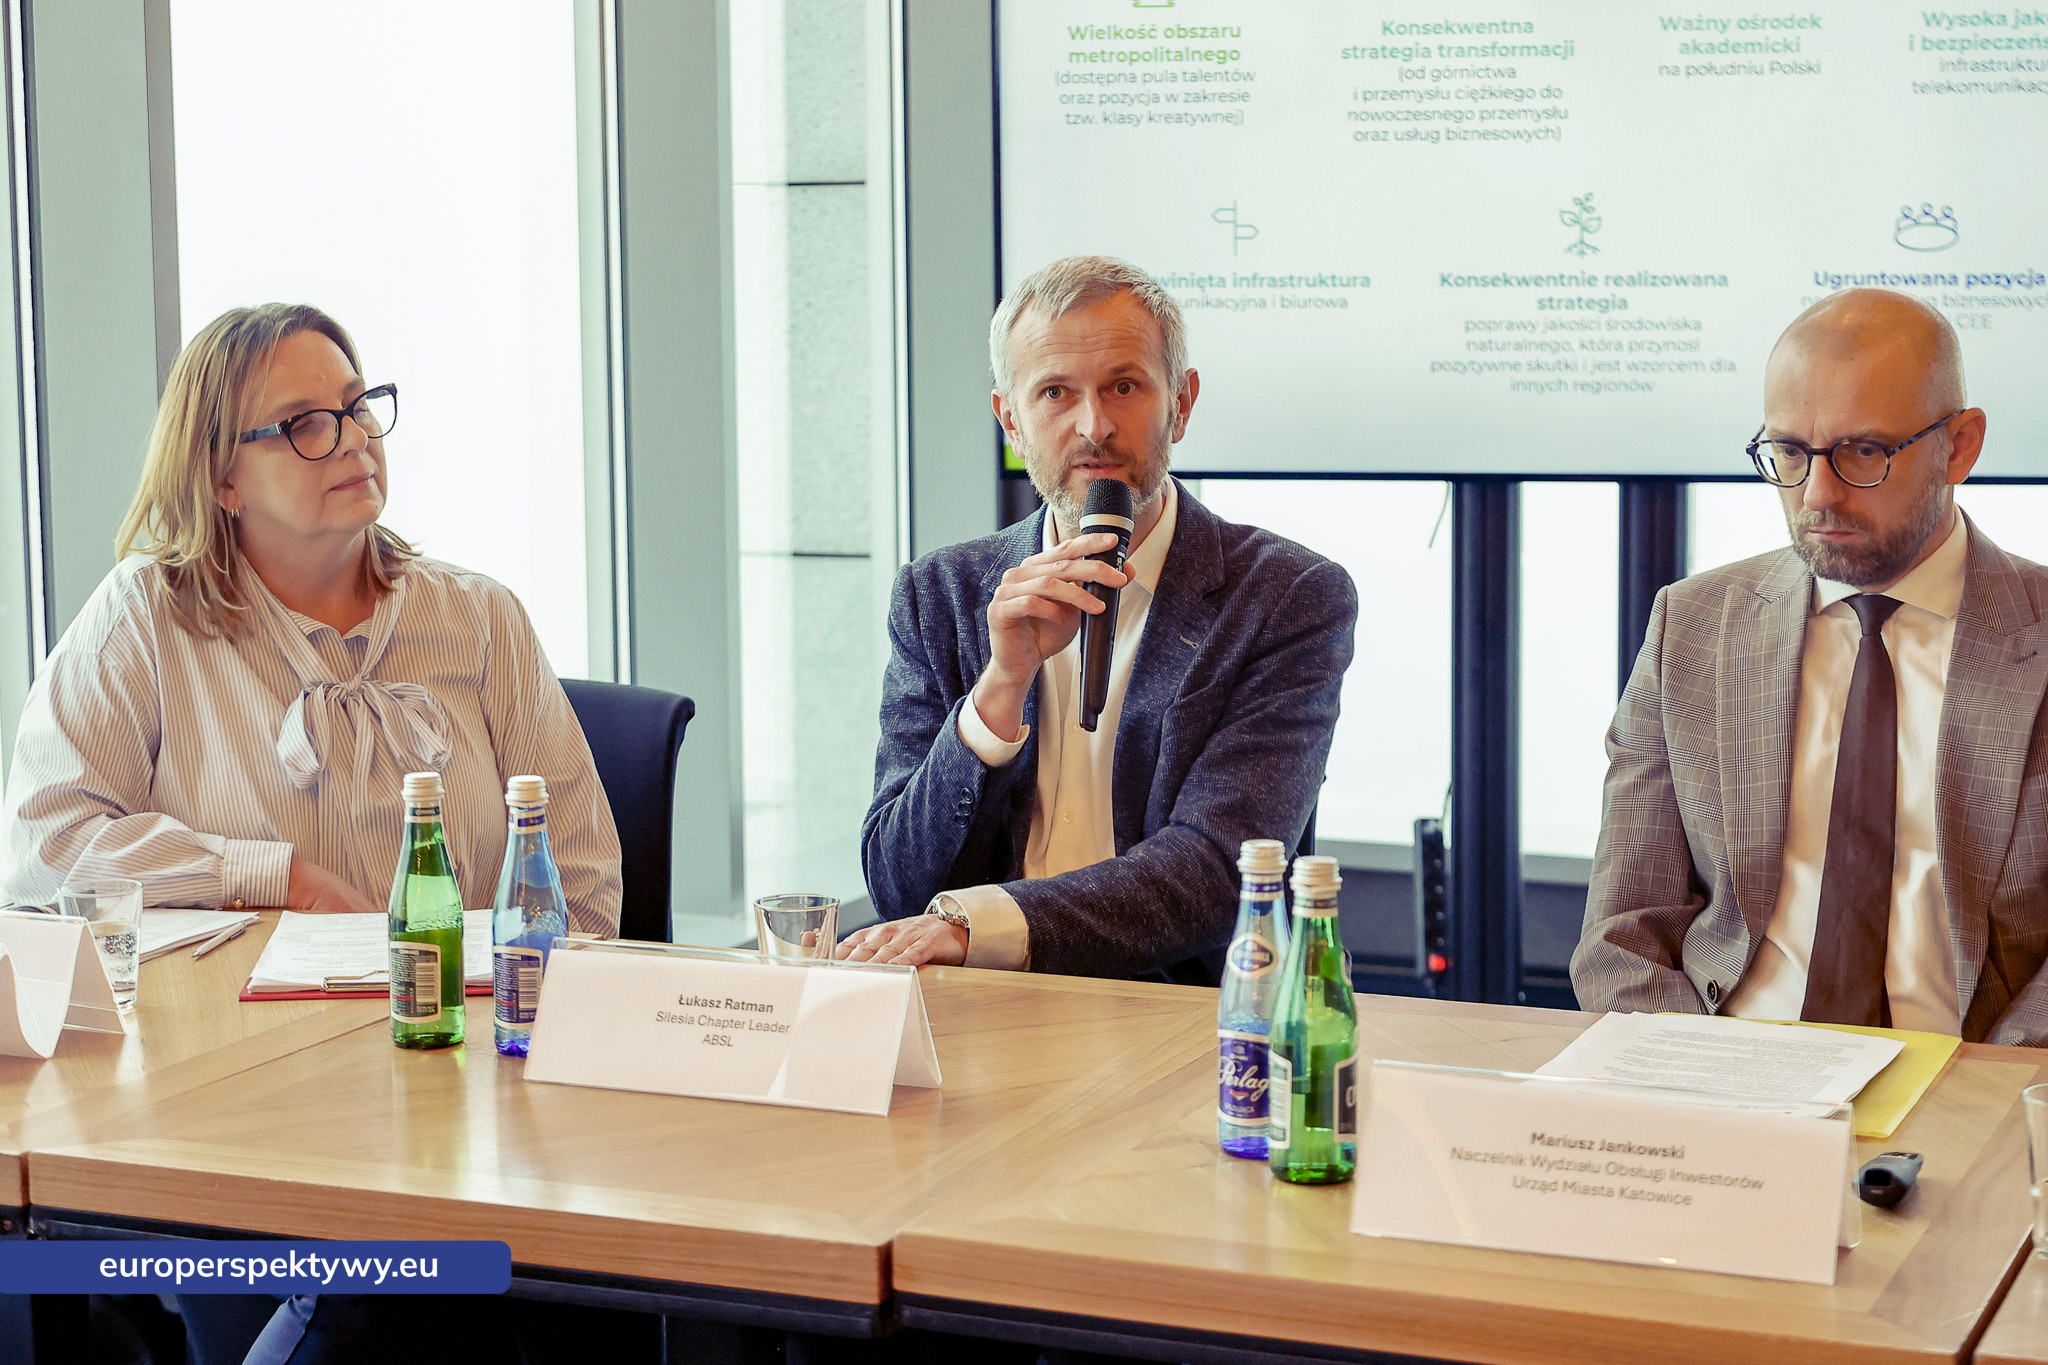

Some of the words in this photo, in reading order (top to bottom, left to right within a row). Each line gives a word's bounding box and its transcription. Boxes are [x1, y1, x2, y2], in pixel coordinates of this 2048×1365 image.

[1381, 20, 1534, 35] Konsekwentna
[1660, 14, 1732, 34] Ważny
[1736, 13, 1822, 31] ośrodek
[1921, 9, 2007, 31] Wysoka
[2011, 8, 2048, 30] jak
[1067, 24, 1158, 40] Wielkość
[1163, 24, 1242, 39] obszaru
[1342, 42, 1431, 61] strategia
[1438, 40, 1575, 60] transformacji
[1679, 36, 1801, 55] akademicki
[1908, 34, 1915, 51] i
[1921, 32, 2048, 54] bezpieczeńs
[1068, 46, 1241, 65] metropolitalnego
[1055, 70, 1137, 86] (dostępna
[1142, 69, 1177, 85] pula
[1182, 68, 1256, 82] talentów
[1398, 65, 1426, 82] (od
[1431, 65, 1517, 82] górnictwa
[1658, 64, 1681, 76] na
[1685, 59, 1765, 79] południu
[1769, 59, 1822, 76] Polski
[1353, 87, 1358, 101] i
[1362, 86, 1450, 103] przemysłu
[1454, 85, 1536, 103] ciężkiego
[1539, 85, 1563, 99] do
[1911, 77, 2048, 96] telekomunikac
[1059, 92, 1094, 104] oraz
[1099, 90, 1160, 106] pozycja
[1166, 92, 1179, 103] w
[1183, 89, 1251, 103] zakresie
[1066, 112, 1098, 125] tzw.
[1102, 110, 1143, 127] klasy
[1149, 109, 1244, 127] kreatywnej)
[1347, 108, 1475, 124] nowoczesnego
[1478, 105, 1569, 122] przemysłu
[1352, 129, 1389, 142] oraz
[1393, 127, 1441, 144] usług
[1444, 125, 1562, 143] biznesowych)
[1152, 272, 1227, 293] winięta
[1233, 273, 1371, 288] infrastruktura
[1439, 271, 1599, 288] Konsekwentnie
[1604, 271, 1729, 288] realizowana
[1813, 271, 1958, 289] Ugruntowana
[1965, 269, 2046, 289] pozycja
[1178, 294, 1267, 312] unikacyjna
[1280, 294, 1349, 309] biurowa
[1537, 294, 1628, 313] strategia
[1943, 294, 2048, 310] biznesowyc
[1463, 319, 1538, 334] poprawy
[1543, 317, 1601, 334] jakości
[1605, 316, 1703, 332] środowiska
[1956, 312, 1993, 329] CEE
[1466, 336, 1575, 354] naturalnego,
[1578, 337, 1624, 352] która
[1628, 337, 1700, 354] przynosi
[1430, 359, 1525, 376] pozytywne
[1527, 357, 1579, 373] skutki
[1590, 358, 1621, 375] jest
[1625, 359, 1706, 373] wzorcem
[1710, 357, 1737, 372] dla
[1510, 377, 1569, 395] innych
[1572, 377, 1655, 395] regionów
[678, 994, 722, 1009] Łukasz
[724, 998, 774, 1013] Ratman
[655, 1011, 694, 1025] Silesia
[697, 1014, 746, 1030] Chapter
[749, 1019, 791, 1034] Leader
[702, 1034, 733, 1047] ABSL
[1219, 1055, 1270, 1102] Perlag
[1530, 1132, 1595, 1151] Mariusz
[1598, 1137, 1686, 1160] Jankowski
[1450, 1147, 1526, 1167] Naczelnik
[1530, 1155, 1601, 1174] Wydziału
[1604, 1161, 1665, 1182] Obsługi
[1669, 1168, 1765, 1190] Inwestorów
[1512, 1175, 1559, 1194] Urząd
[1562, 1179, 1615, 1198] Miasta
[1618, 1186, 1693, 1206] Katowice
